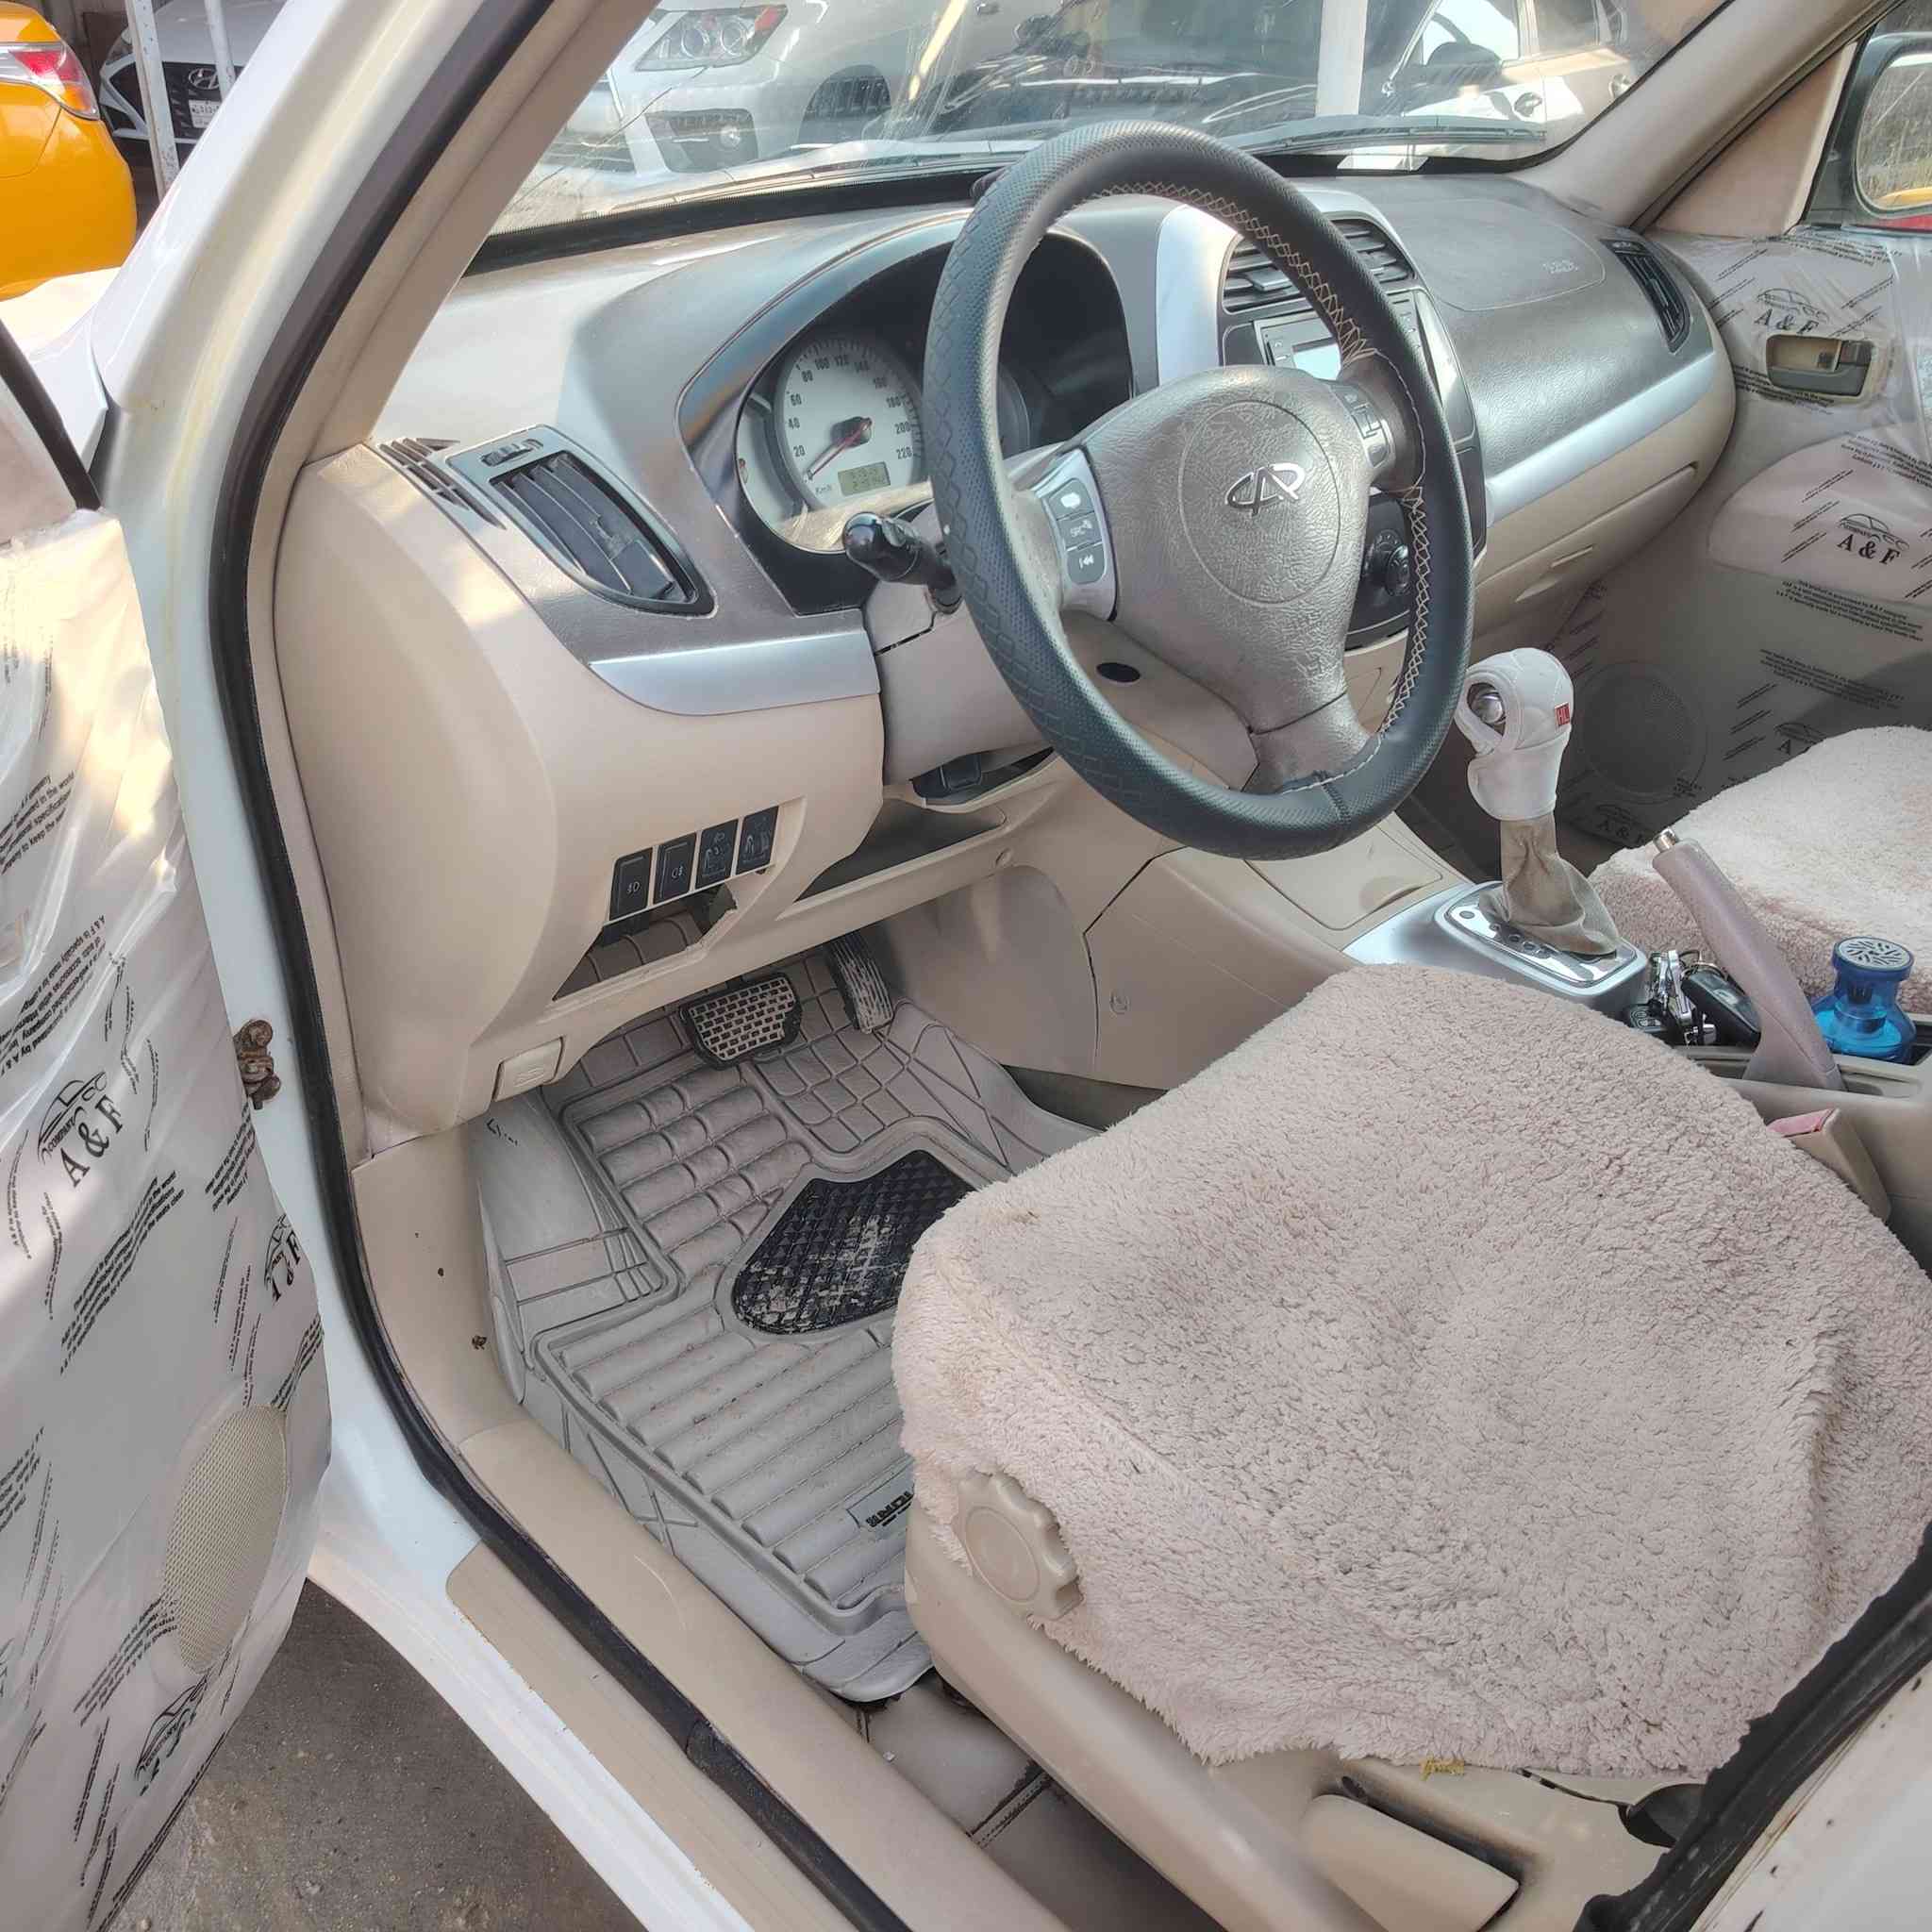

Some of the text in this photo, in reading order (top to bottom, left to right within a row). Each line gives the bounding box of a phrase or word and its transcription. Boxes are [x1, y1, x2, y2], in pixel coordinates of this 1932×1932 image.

[788, 417, 800, 429] 40
[894, 421, 911, 434] 200
[793, 444, 806, 457] 20
[895, 446, 912, 459] 220
[1837, 534, 1854, 552] A
[1858, 541, 1876, 558] &
[1879, 548, 1900, 565] F
[1777, 739, 1792, 756] A
[60, 1147, 91, 1188] A
[78, 1123, 109, 1158] &
[94, 1094, 123, 1134] F
